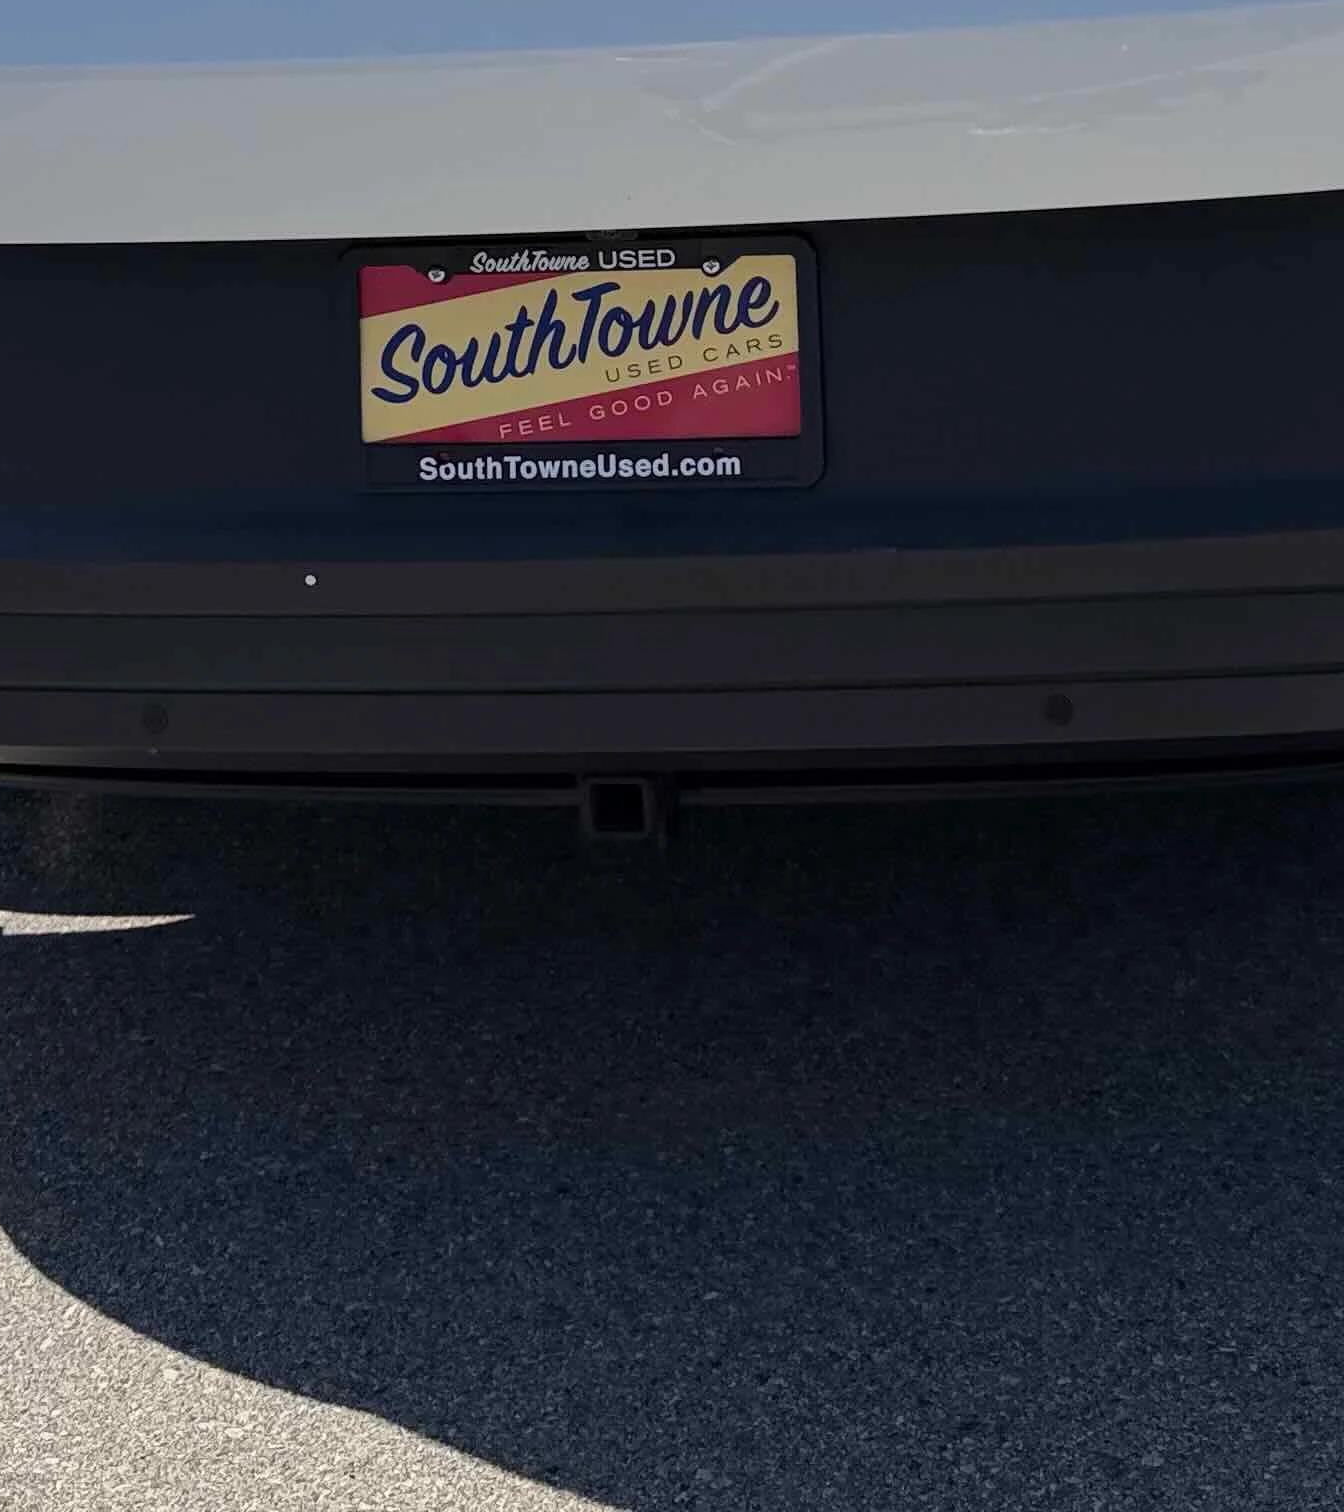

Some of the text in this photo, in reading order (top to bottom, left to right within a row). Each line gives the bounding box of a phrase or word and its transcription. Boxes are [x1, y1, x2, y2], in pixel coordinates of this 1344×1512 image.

[470, 249, 676, 273] SouthTowne USED
[371, 276, 779, 404] SouthTowne
[605, 334, 783, 383] USED CARS
[498, 412, 573, 439] FEEL
[589, 390, 673, 421] GOOD
[419, 453, 741, 481] SouthTowneUsed.com
